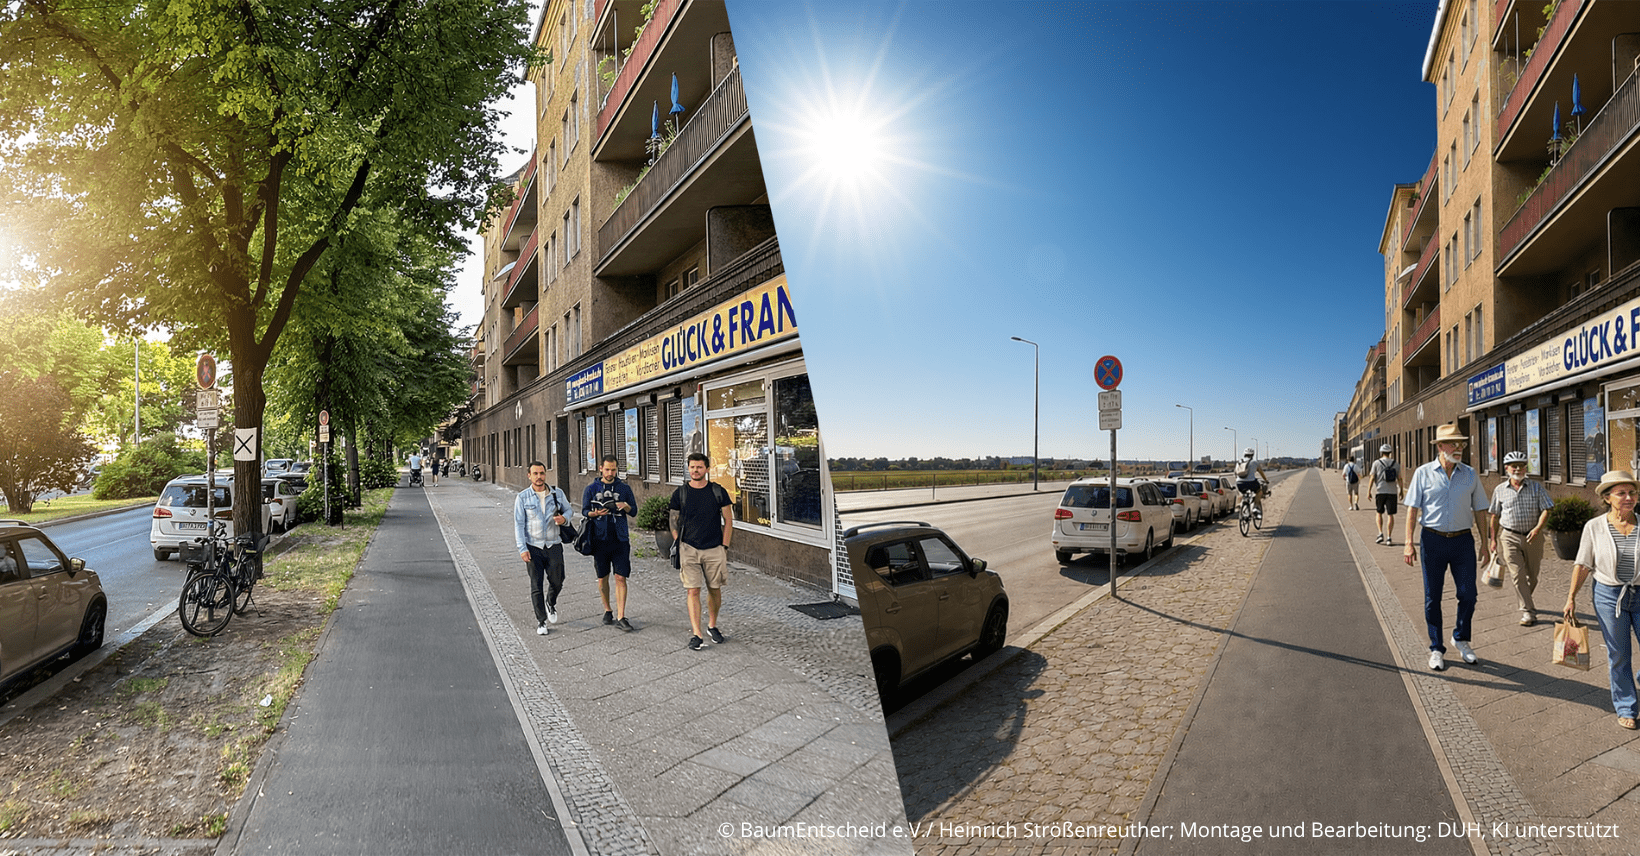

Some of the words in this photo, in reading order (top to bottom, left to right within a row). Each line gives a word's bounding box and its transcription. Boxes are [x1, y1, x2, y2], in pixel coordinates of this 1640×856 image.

[662, 319, 711, 371] GLÜCK
[712, 313, 726, 355] &
[1563, 320, 1613, 372] GLÜCK
[1613, 315, 1628, 355] &
